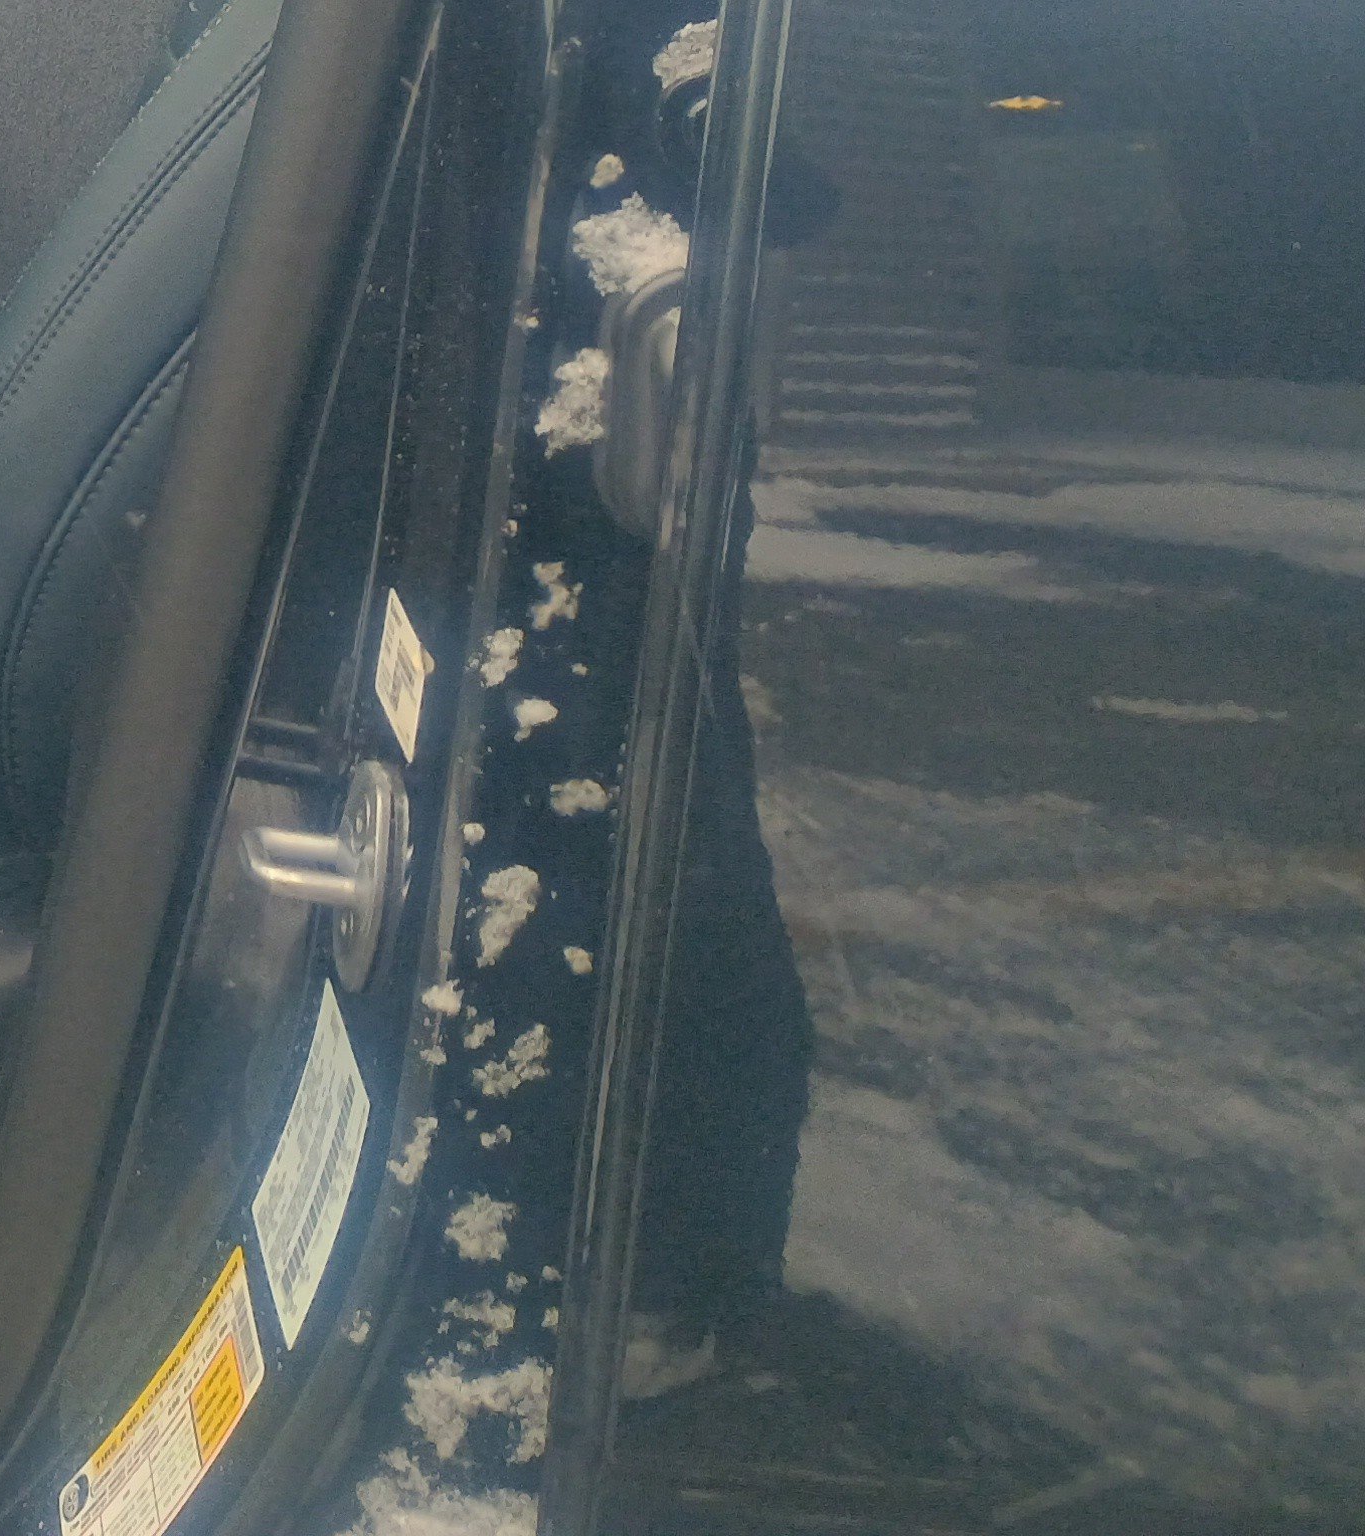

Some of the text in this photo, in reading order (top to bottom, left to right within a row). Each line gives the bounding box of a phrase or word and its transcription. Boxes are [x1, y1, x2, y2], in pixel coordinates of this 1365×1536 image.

[95, 1439, 118, 1469] TIRE
[120, 1416, 141, 1443] AND
[141, 1355, 181, 1415] LOADING
